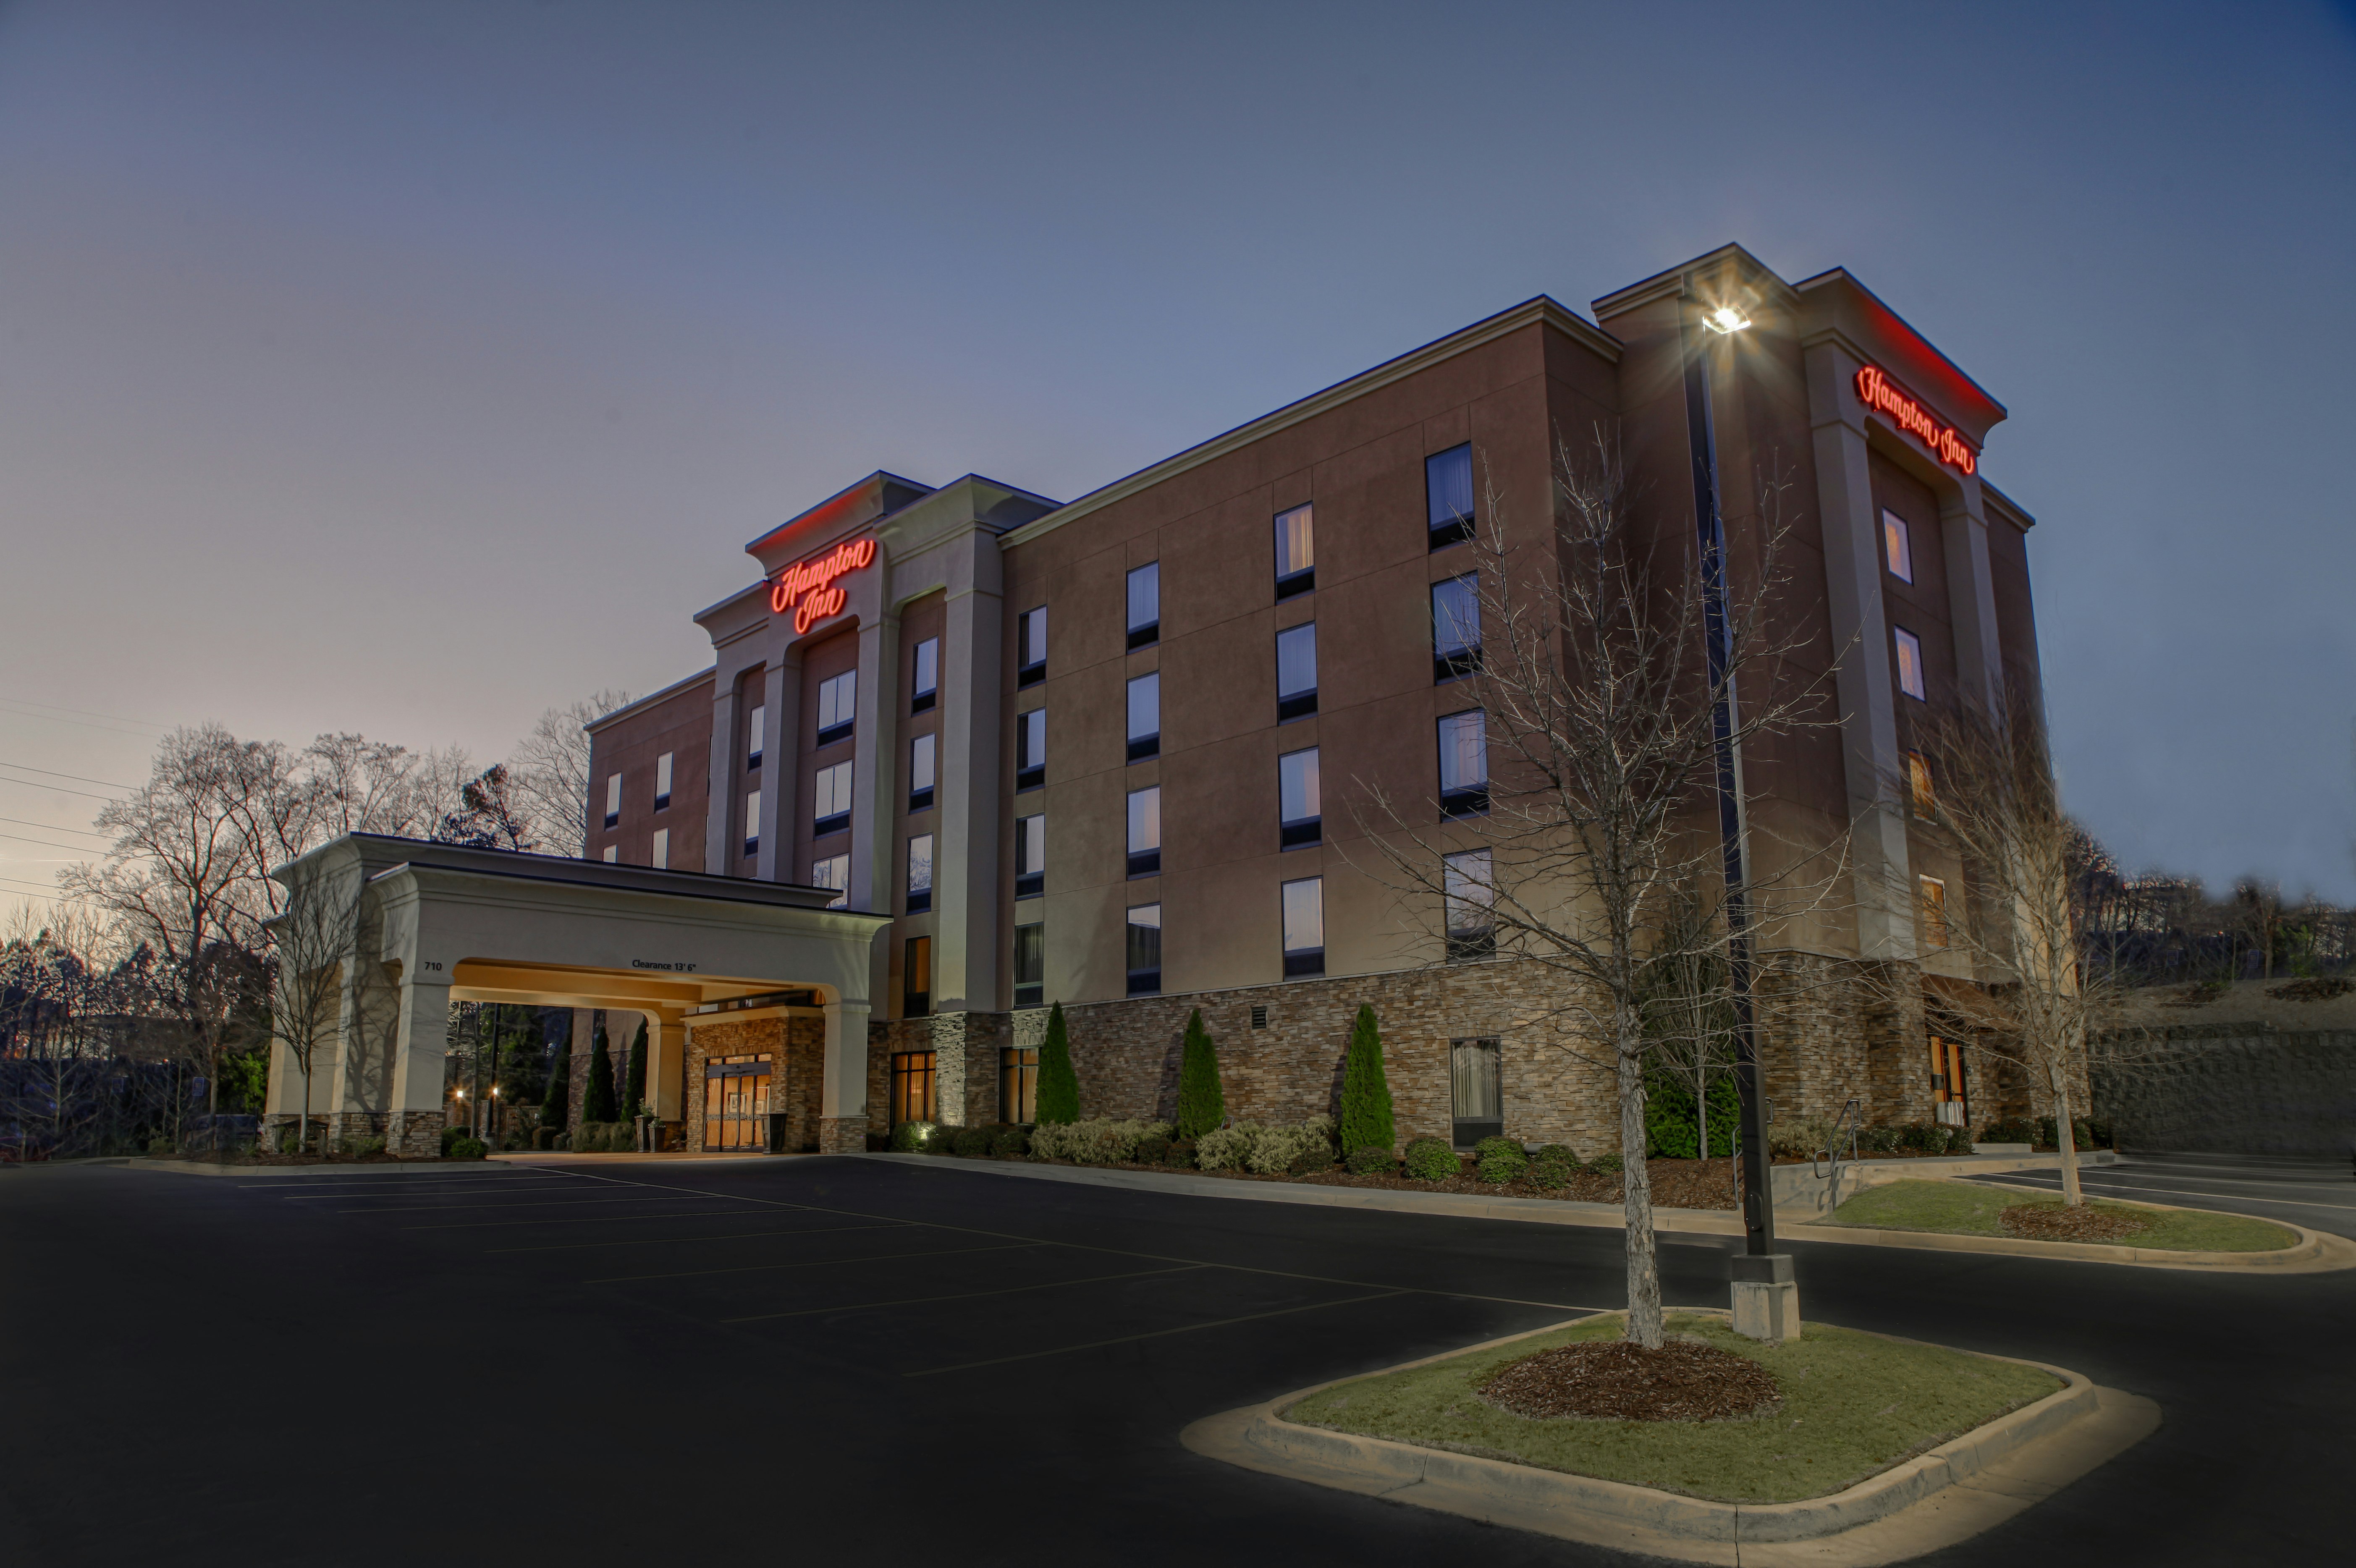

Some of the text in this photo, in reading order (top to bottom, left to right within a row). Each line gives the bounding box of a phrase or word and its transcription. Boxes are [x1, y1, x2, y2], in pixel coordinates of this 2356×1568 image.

[1858, 366, 1974, 475] Hampton Inn
[772, 539, 874, 613] Hampton
[795, 588, 845, 633] Inn
[425, 961, 442, 971] 710
[632, 959, 671, 970] Clearance
